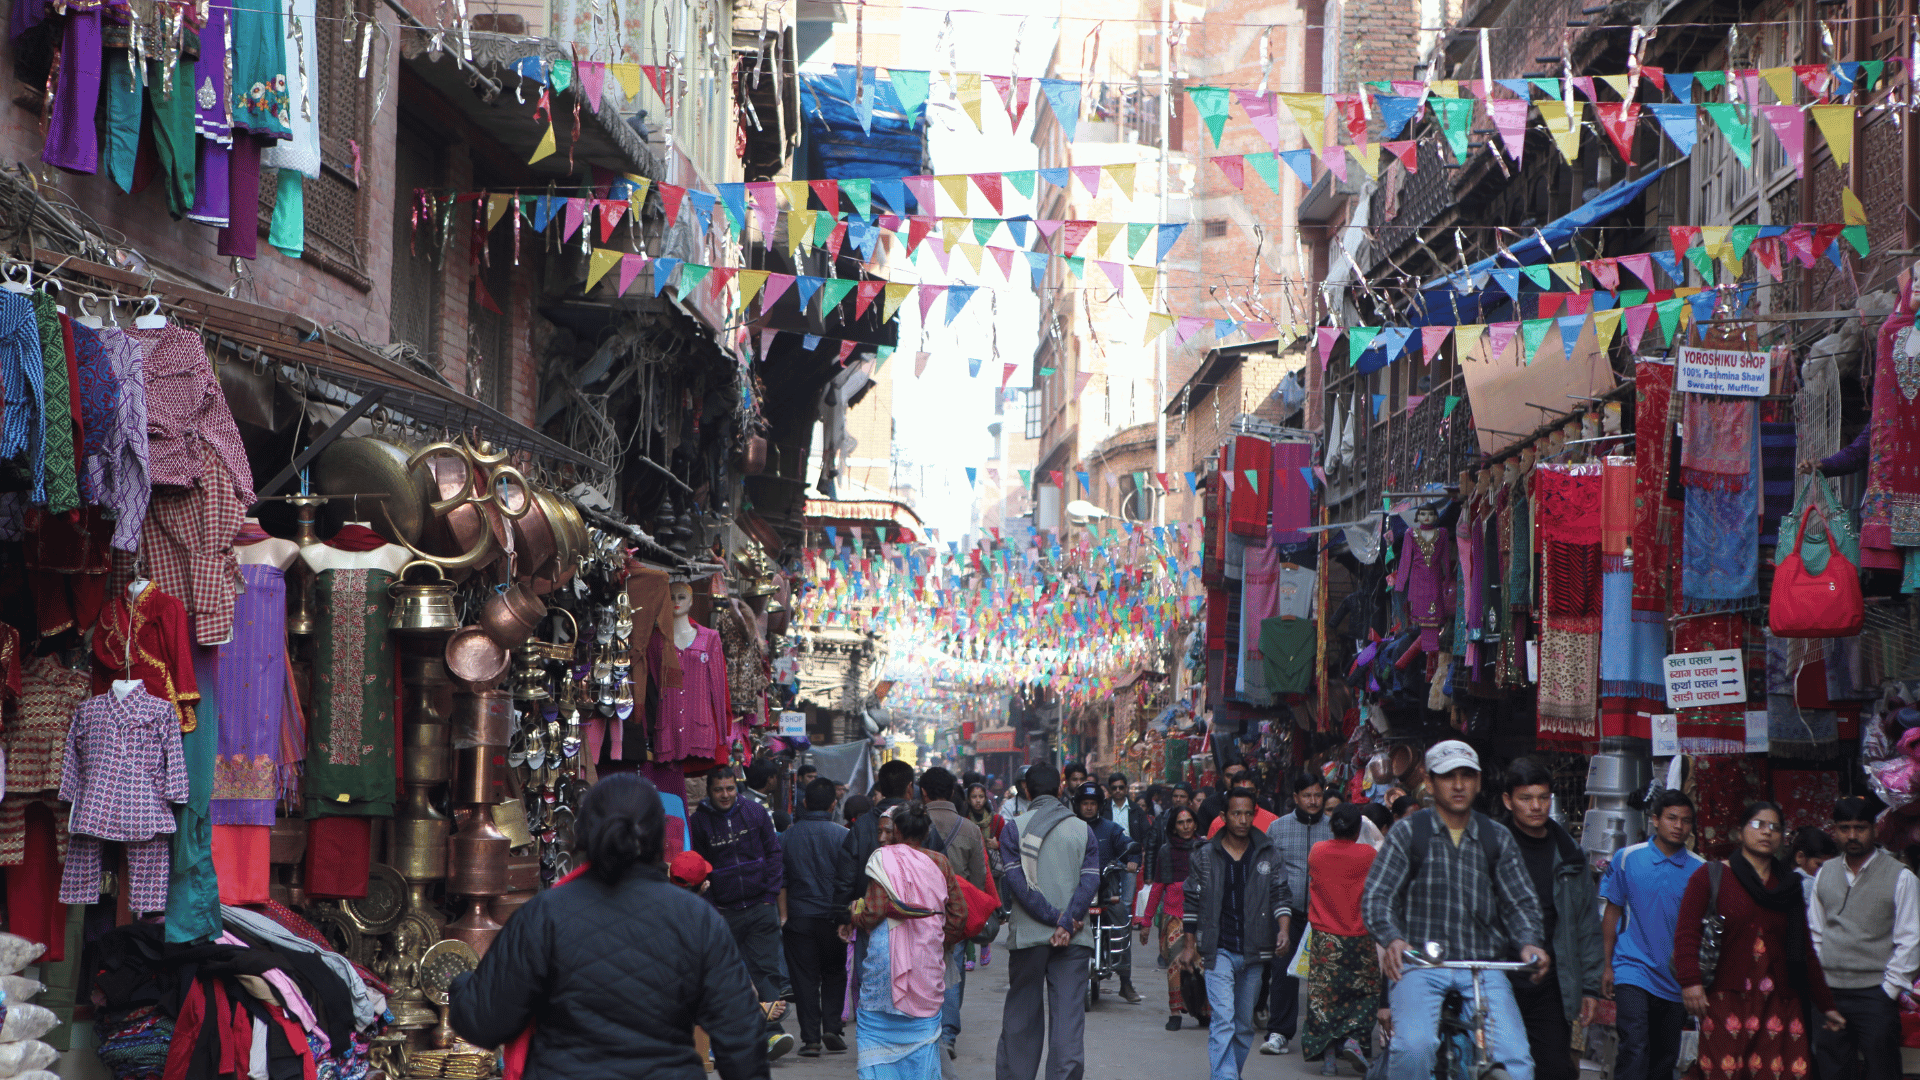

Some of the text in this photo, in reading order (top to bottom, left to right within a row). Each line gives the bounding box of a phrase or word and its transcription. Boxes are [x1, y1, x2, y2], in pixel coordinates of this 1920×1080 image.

[1684, 351, 1766, 369] YOROSHIKU SHOP
[1682, 367, 1765, 382] 100% Pashmina Shawl
[1687, 380, 1759, 392] Sweater, Muffler
[1668, 656, 1712, 667] सल पसल
[1670, 668, 1718, 678] ब्याग पसल
[1694, 680, 1718, 688] पसल
[1672, 691, 1720, 702] साडी पसल
